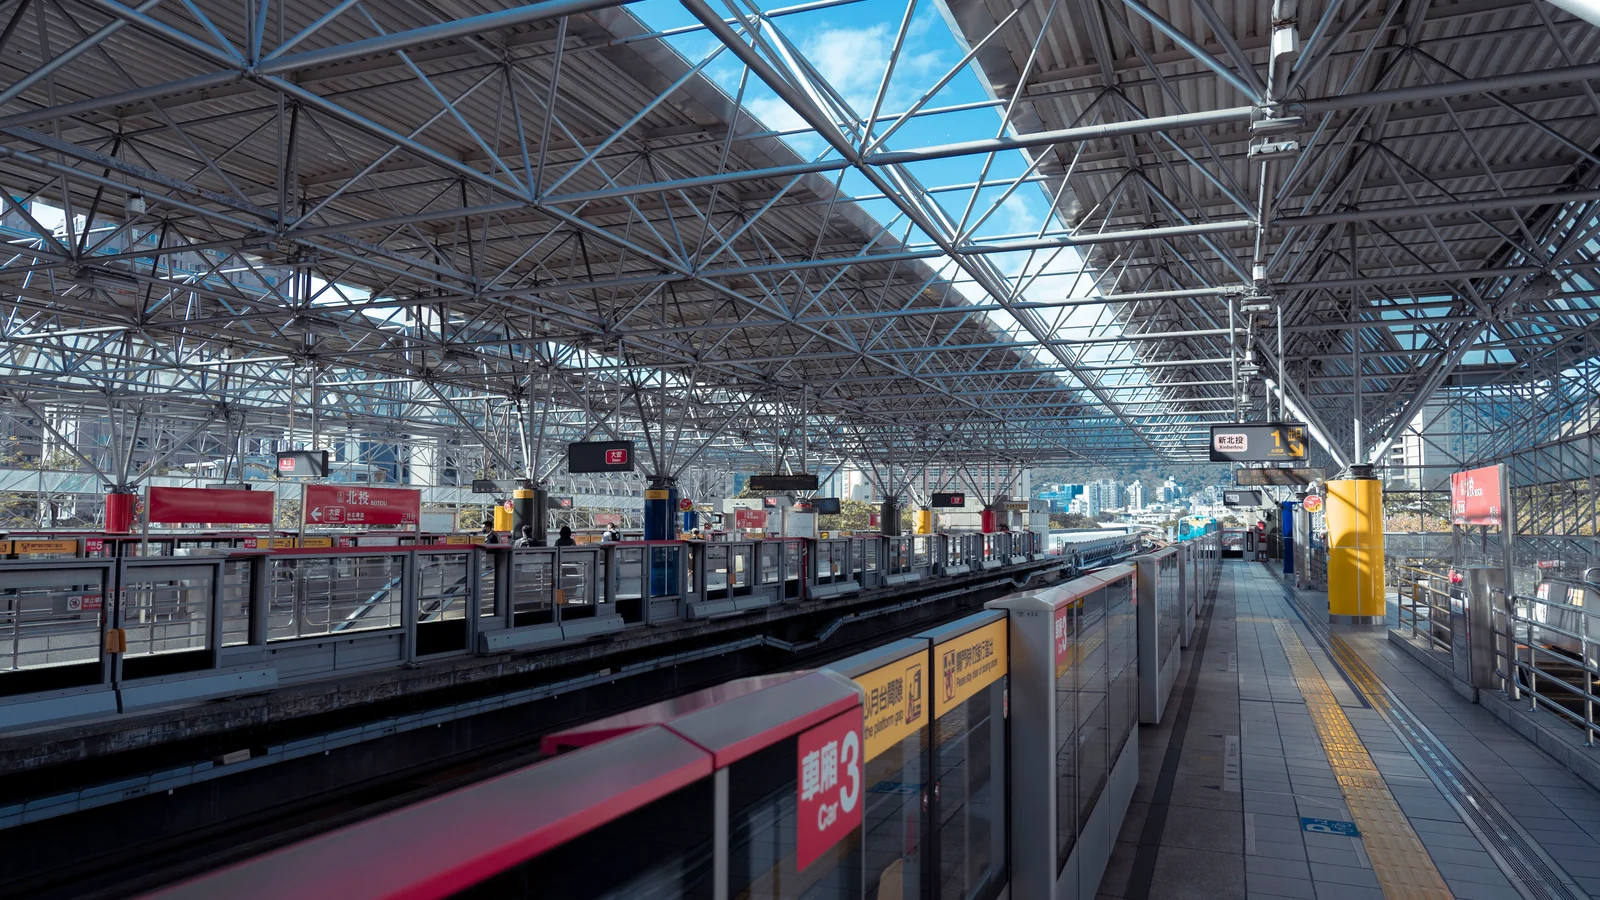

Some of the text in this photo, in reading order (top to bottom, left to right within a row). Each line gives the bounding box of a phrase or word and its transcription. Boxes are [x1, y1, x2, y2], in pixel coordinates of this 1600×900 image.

[1218, 436, 1244, 445] 新北投
[1270, 429, 1281, 447] 1
[1287, 427, 1303, 442] 出口
[346, 490, 370, 505] 北投
[328, 508, 341, 516] 大安
[96, 541, 103, 550] 5
[251, 539, 257, 548] 5
[1062, 615, 1067, 651] 3
[873, 714, 895, 739] platform
[894, 709, 904, 727] gap
[801, 740, 838, 801] 車廂
[839, 730, 860, 813] 3
[817, 802, 838, 831] Car
